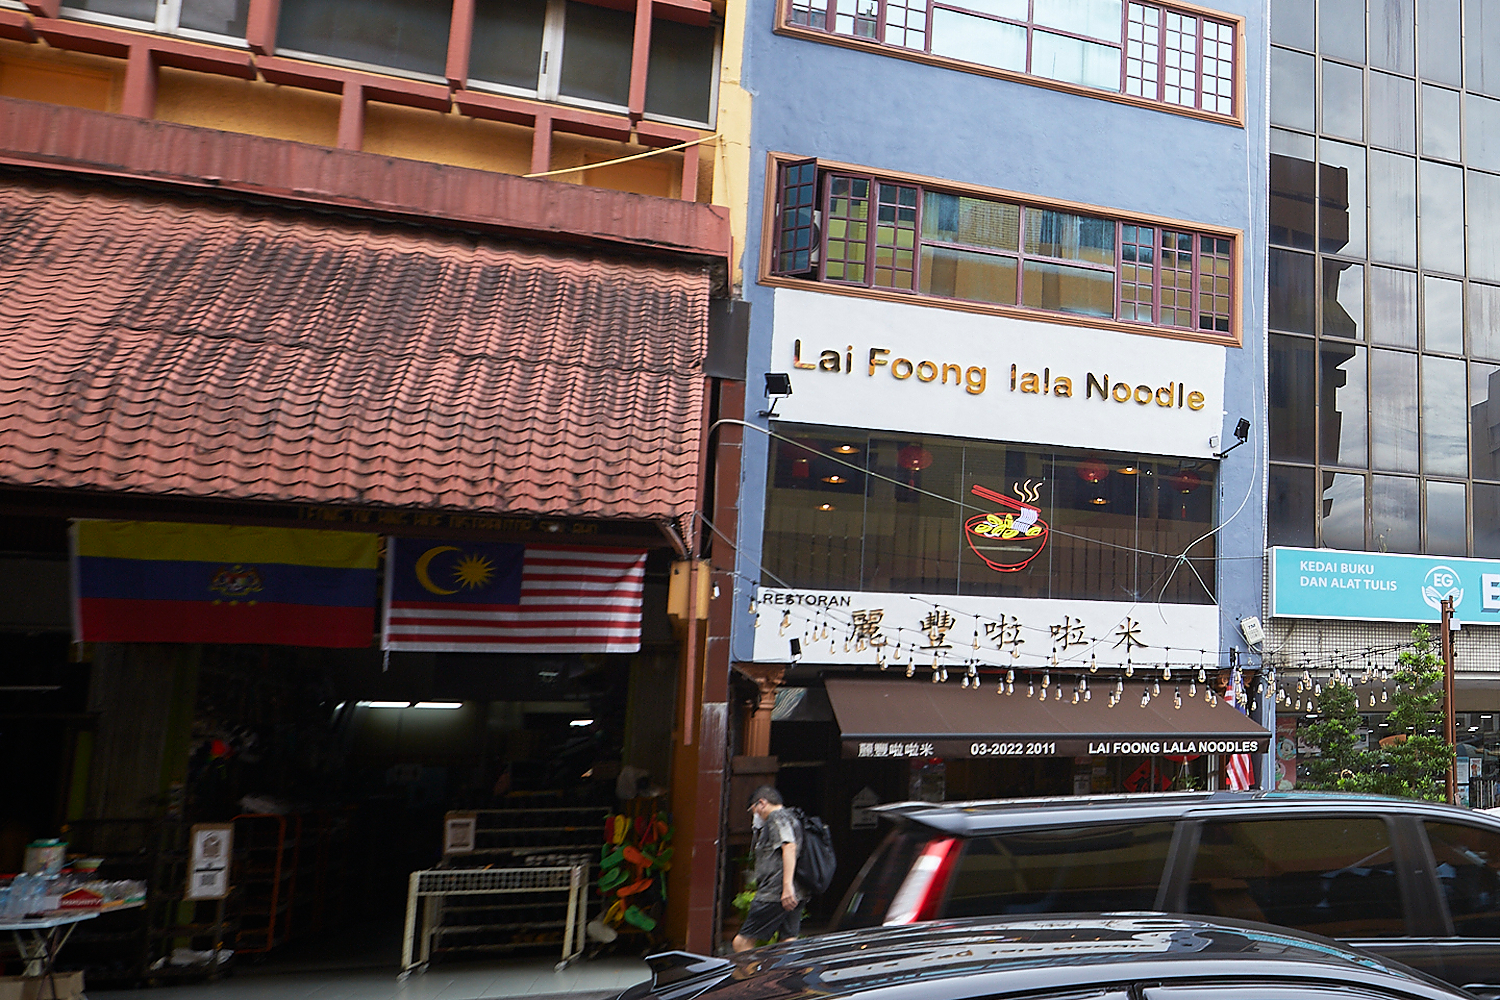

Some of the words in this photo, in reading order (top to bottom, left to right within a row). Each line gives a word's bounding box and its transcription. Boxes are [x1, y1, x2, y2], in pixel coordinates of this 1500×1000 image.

[792, 339, 853, 375] Lai
[868, 347, 987, 395] Foong
[1010, 363, 1075, 399] lala
[1085, 372, 1206, 412] Noodle
[1300, 560, 1337, 573] KEDAI
[1341, 563, 1375, 575] BUKU
[1300, 576, 1327, 588] DAN
[1332, 578, 1361, 589] ALAT
[1364, 579, 1398, 592] TULIS
[1433, 573, 1453, 587] EG
[763, 593, 851, 607] RESTORAN
[850, 607, 1147, 654] 麗豐啦啦米
[970, 743, 1024, 756] 03-2022
[1026, 742, 1056, 756] 2011
[1088, 742, 1110, 754] LAI
[1112, 742, 1160, 754] FOONG
[1162, 741, 1196, 753] LALA
[1197, 740, 1258, 754] NOODLES
